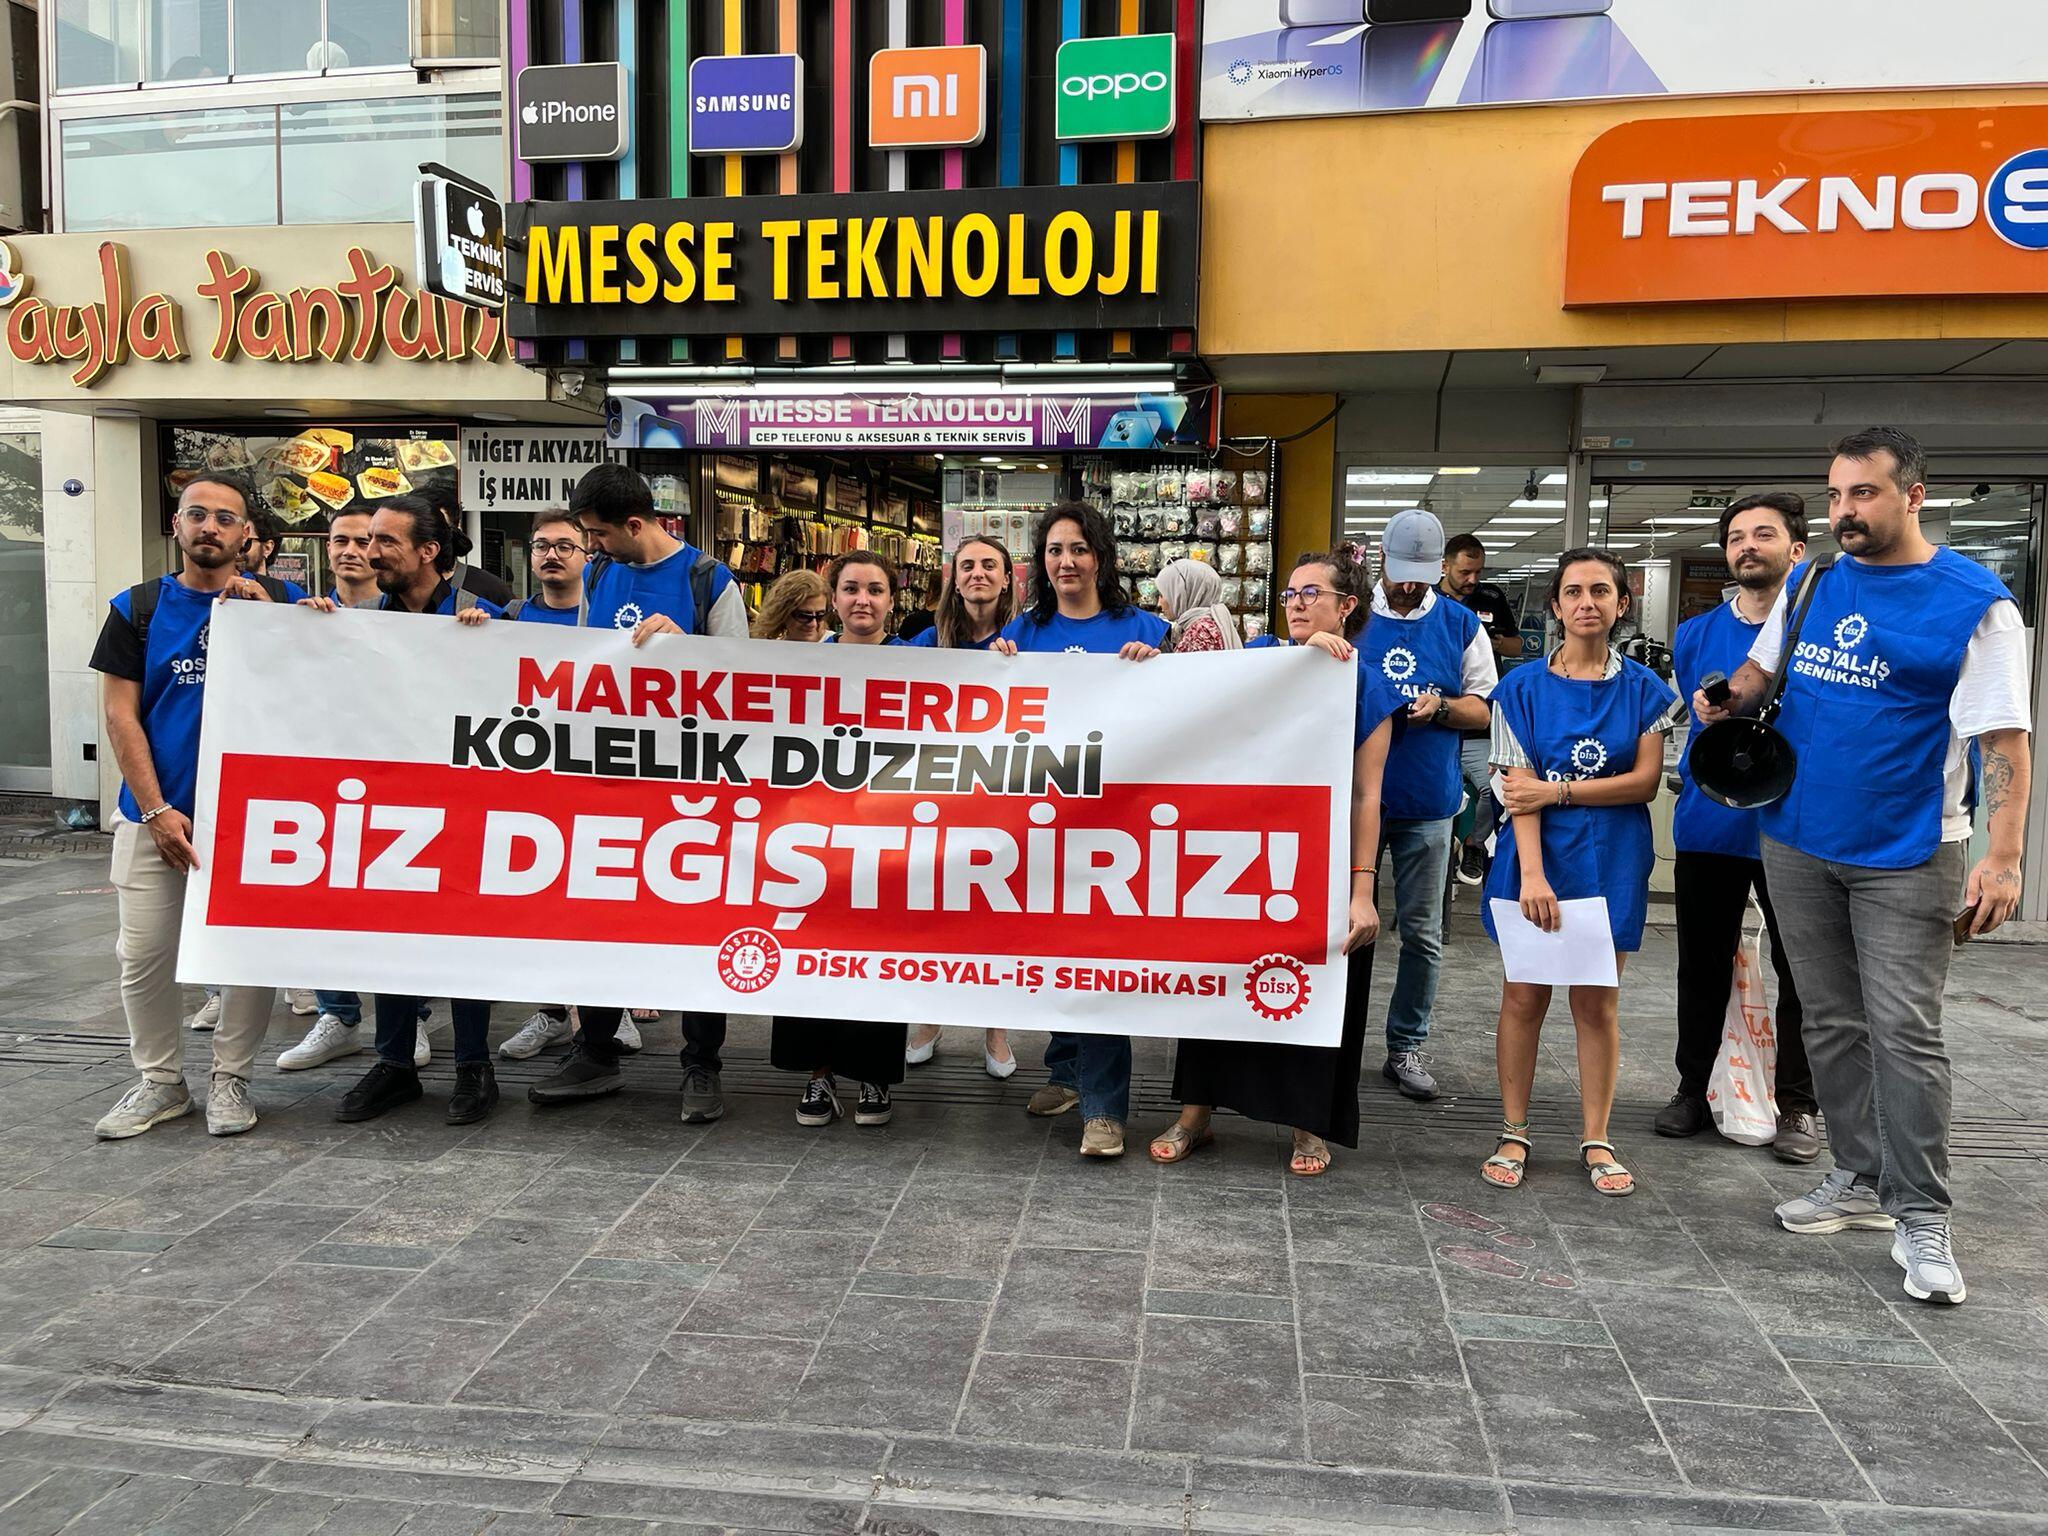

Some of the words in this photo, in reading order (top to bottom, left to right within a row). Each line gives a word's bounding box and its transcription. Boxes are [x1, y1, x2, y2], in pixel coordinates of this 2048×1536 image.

[1062, 71, 1168, 99] oppo
[1258, 68, 1292, 79] Xiaomi
[1294, 65, 1342, 79] HyperOS
[541, 101, 616, 126] iPhone
[696, 91, 791, 113] SAMSUNG
[450, 234, 503, 269] TEKNİK
[525, 221, 736, 304] MESSE
[761, 210, 1160, 300] TEKNOLOJI
[463, 267, 504, 297] ERVİS
[7, 241, 184, 388] ayla
[197, 246, 516, 362] tantun
[750, 400, 851, 422] MESSE
[866, 393, 1032, 422] TEKNOLOJİ
[468, 432, 524, 463] NİGET
[756, 433, 777, 443] CEP
[782, 432, 841, 443] TELEFONU
[846, 432, 853, 443] &
[858, 432, 919, 443] AKSESUAR
[924, 432, 932, 442] &
[936, 429, 979, 443] TEKNİK
[983, 429, 1026, 442] SERVİS
[479, 469, 497, 506] İŞ
[502, 478, 551, 500] HANI
[1793, 660, 1878, 689] SENDİKASI
[1794, 641, 1891, 682] SOSYAL-İŞ
[518, 657, 1049, 734] MARKETLERDE
[452, 706, 749, 784] KÖLELİK
[771, 726, 1103, 796] DÜZENİNİ
[241, 778, 446, 892] BİZ
[479, 795, 1300, 930] DEĞİŞTİRİRİZ!
[797, 953, 870, 980] DİSK
[880, 959, 1045, 993] SOSYAL-İŞ
[1055, 968, 1227, 997] SENDİKASI
[1259, 977, 1297, 995] DİSK
